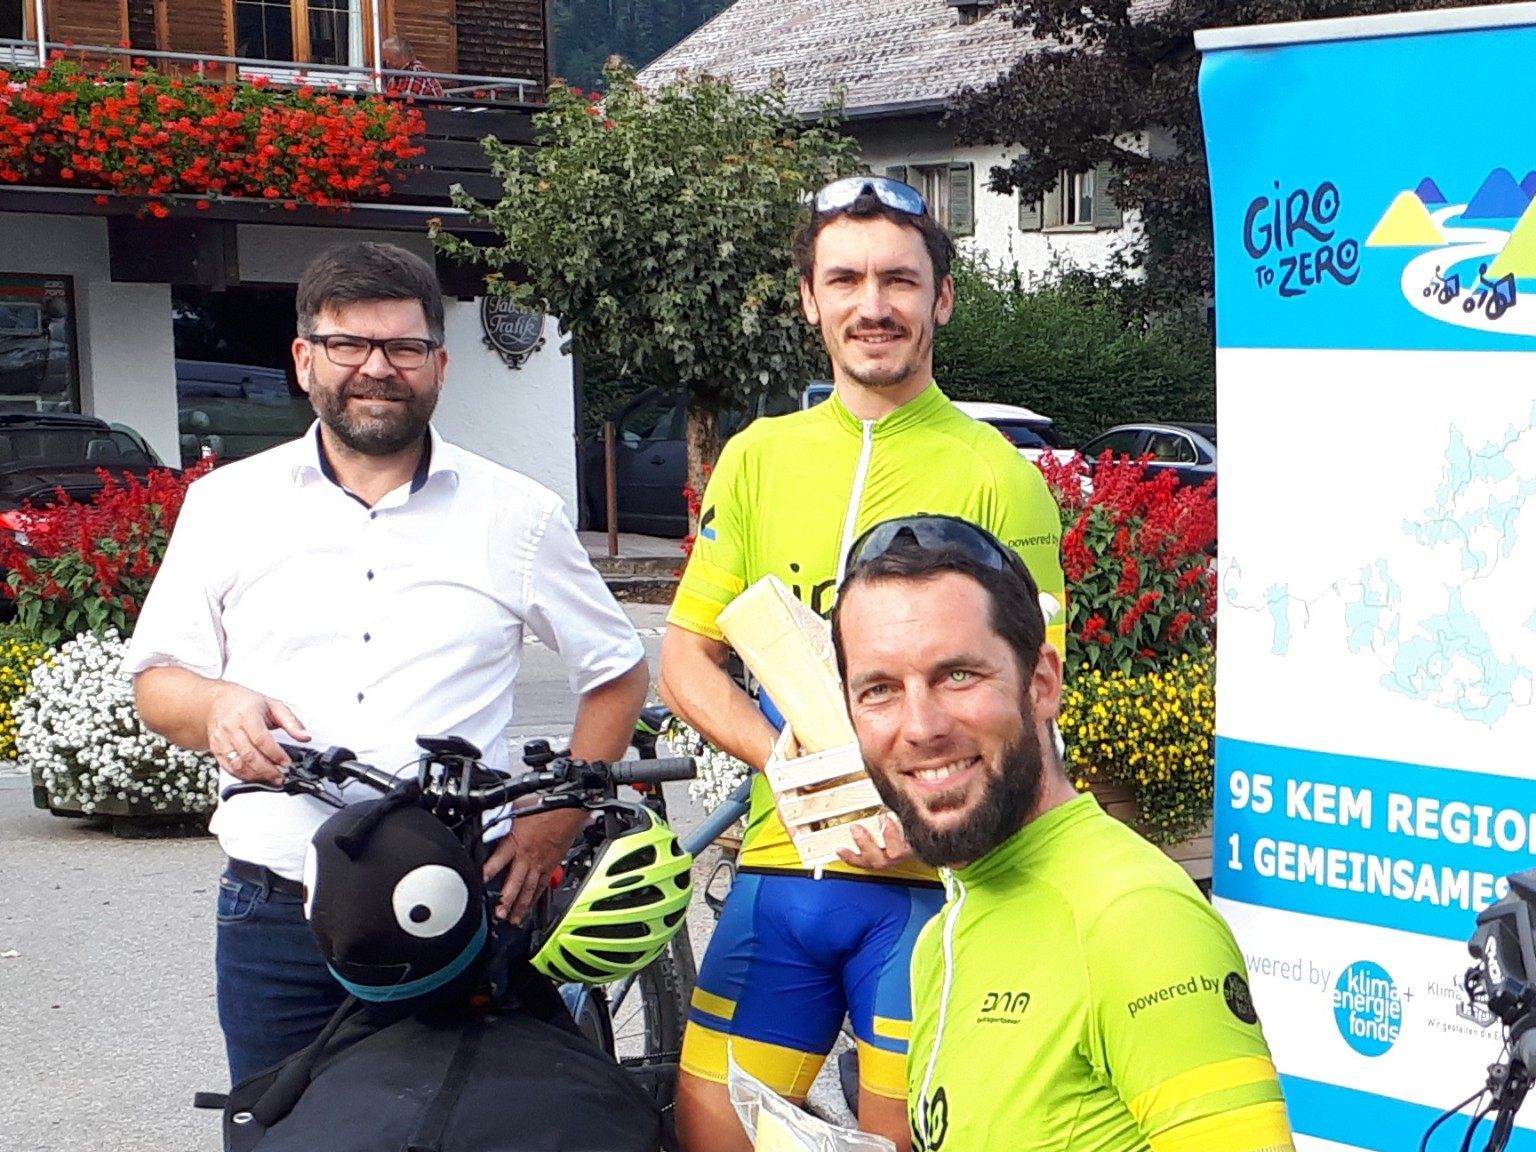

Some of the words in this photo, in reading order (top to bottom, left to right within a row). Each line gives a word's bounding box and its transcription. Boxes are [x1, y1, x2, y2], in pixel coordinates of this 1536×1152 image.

[1278, 237, 1360, 297] ZERO
[1229, 771, 1273, 813] 95
[1286, 779, 1372, 829] KEM
[1229, 834, 1242, 870] 1
[1246, 954, 1302, 981] wered
[1310, 961, 1331, 992] by
[1349, 969, 1398, 998] klima
[1128, 976, 1198, 1018] powered
[1200, 975, 1220, 997] by
[1333, 988, 1400, 1021] energie
[1350, 1015, 1400, 1045] fonds
